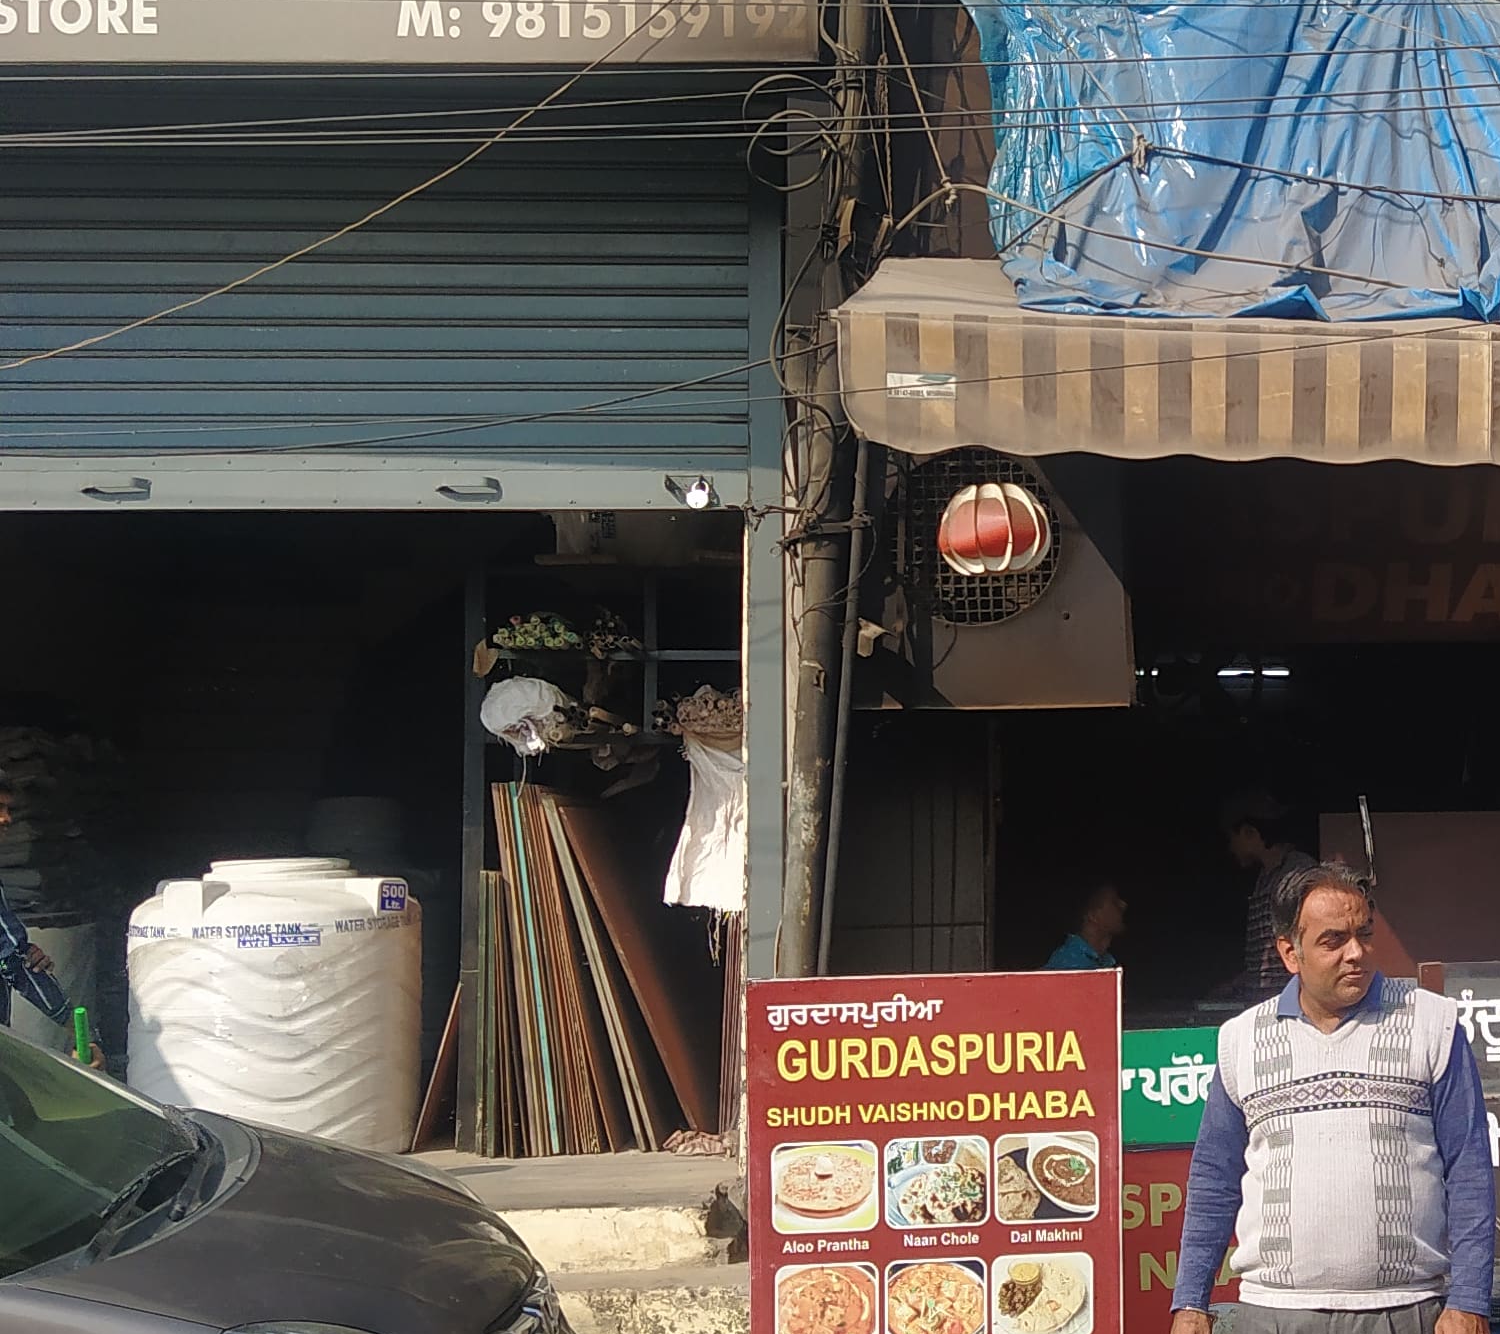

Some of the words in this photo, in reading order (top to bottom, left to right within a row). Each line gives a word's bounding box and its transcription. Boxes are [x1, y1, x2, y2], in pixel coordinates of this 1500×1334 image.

[382, 885, 405, 898] 500
[192, 926, 223, 939] WATER
[225, 923, 271, 938] STORAGE
[275, 922, 302, 935] TANK
[335, 918, 365, 933] WATER
[766, 993, 944, 1032] ਗੁਰਦਾਸਪੁਰੀਆ
[776, 1030, 1086, 1082] GURDASPURIA
[767, 1105, 851, 1127] SHUDH
[858, 1100, 965, 1124] VAISHNO
[967, 1089, 1095, 1122] DHABA
[903, 1232, 938, 1247] Naan
[940, 1231, 980, 1246] Chole
[1010, 1230, 1033, 1244] Dal
[1035, 1227, 1083, 1243] Makhni
[782, 1238, 815, 1254] Aloo
[818, 1237, 870, 1252] Prantha
